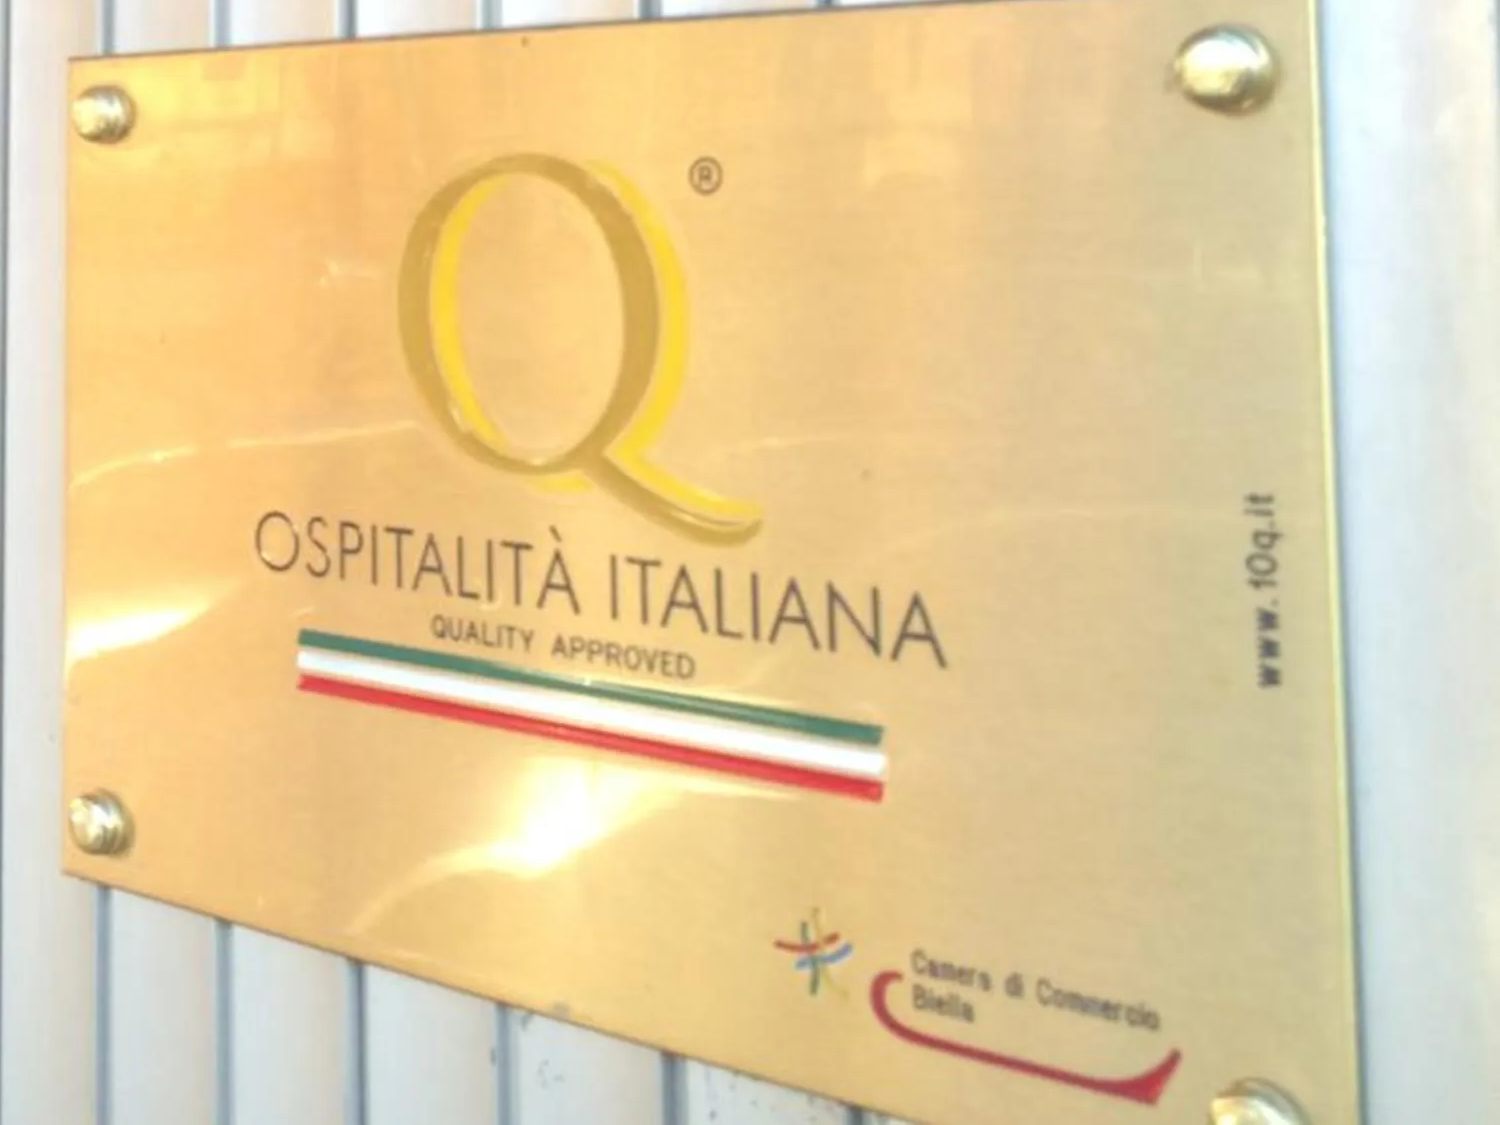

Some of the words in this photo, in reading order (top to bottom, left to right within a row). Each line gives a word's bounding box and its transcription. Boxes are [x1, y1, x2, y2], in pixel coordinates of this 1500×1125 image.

[398, 152, 763, 547] Q
[254, 510, 581, 616] OSPITALITÀ
[608, 553, 949, 671] ITALIANA
[430, 613, 534, 653] QUALITY
[551, 634, 696, 680] APPROVED
[911, 949, 993, 994] Camera
[1004, 971, 1025, 997] di
[1036, 979, 1162, 1032] Commercio
[912, 984, 975, 1024] Biella
